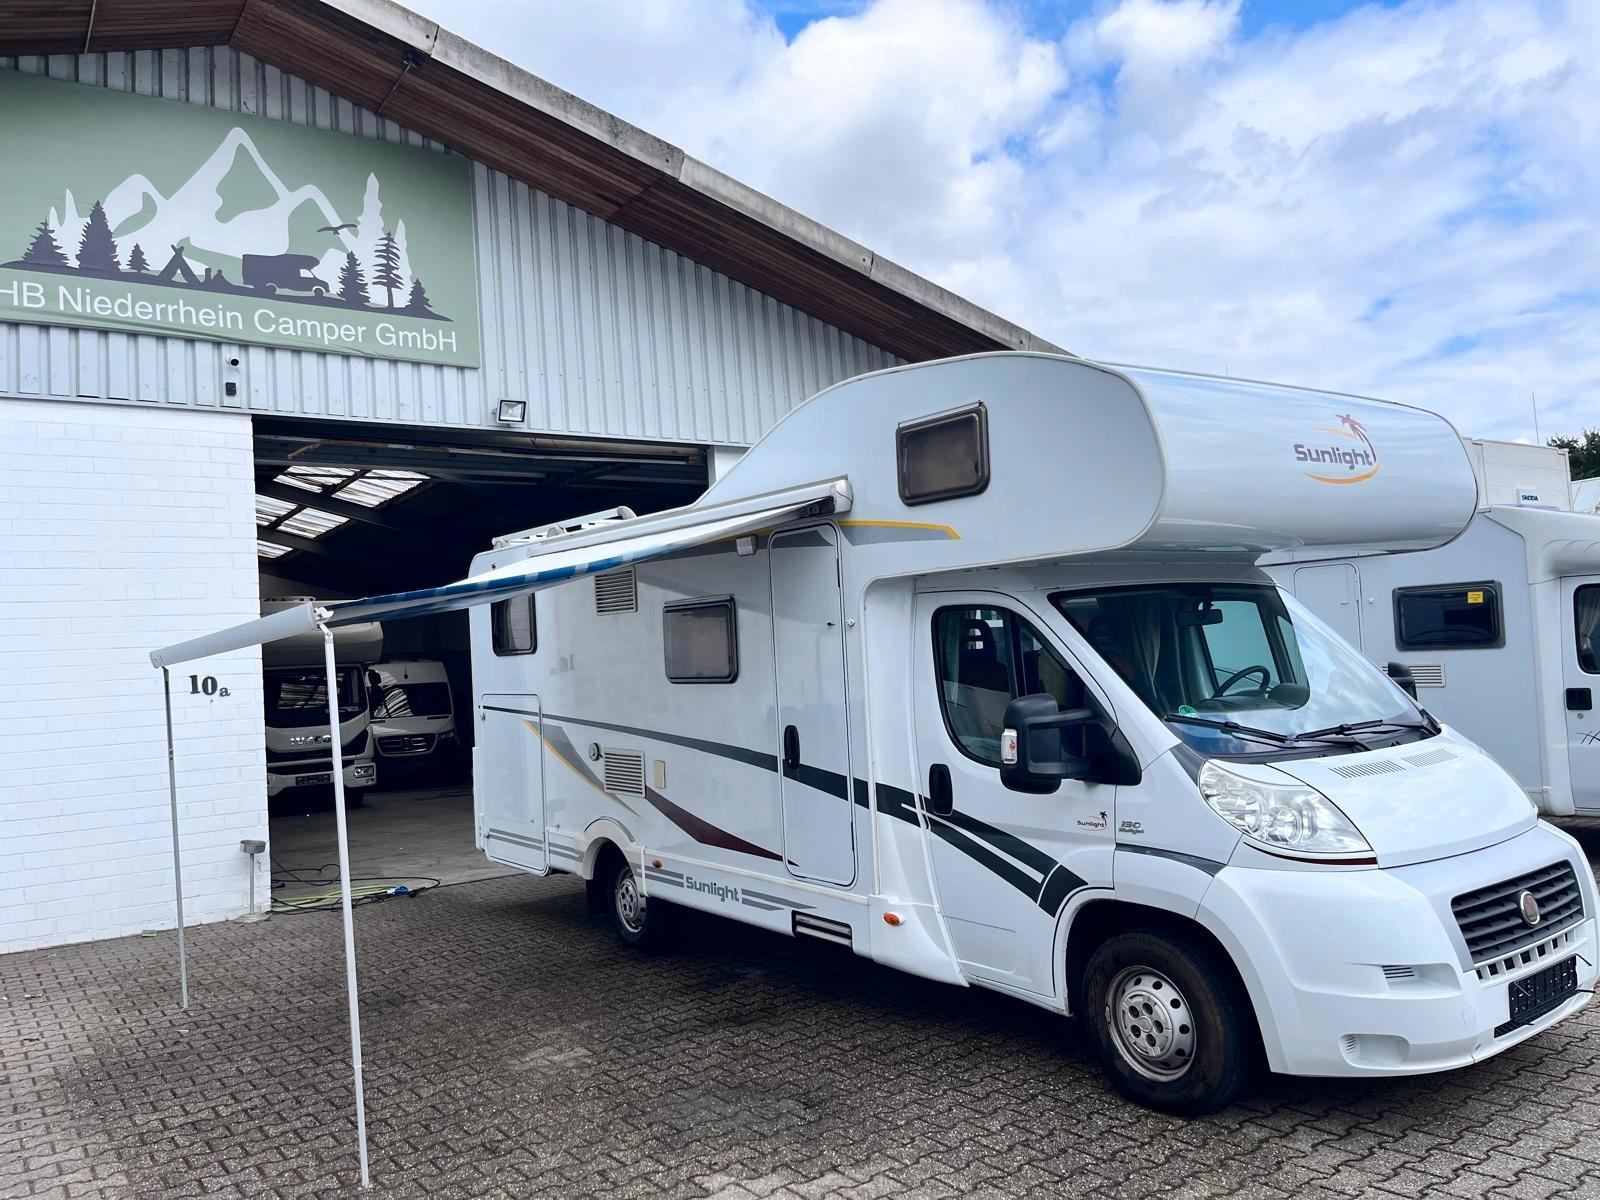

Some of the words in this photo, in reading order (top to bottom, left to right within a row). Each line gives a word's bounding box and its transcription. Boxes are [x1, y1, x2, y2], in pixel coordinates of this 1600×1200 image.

[58, 285, 243, 330] Niederrhein
[254, 309, 367, 345] Camper
[375, 323, 457, 353] GmbH
[1293, 443, 1373, 470] Sunlight
[1077, 820, 1105, 829] Sunlight
[685, 876, 740, 902] Sunlight
